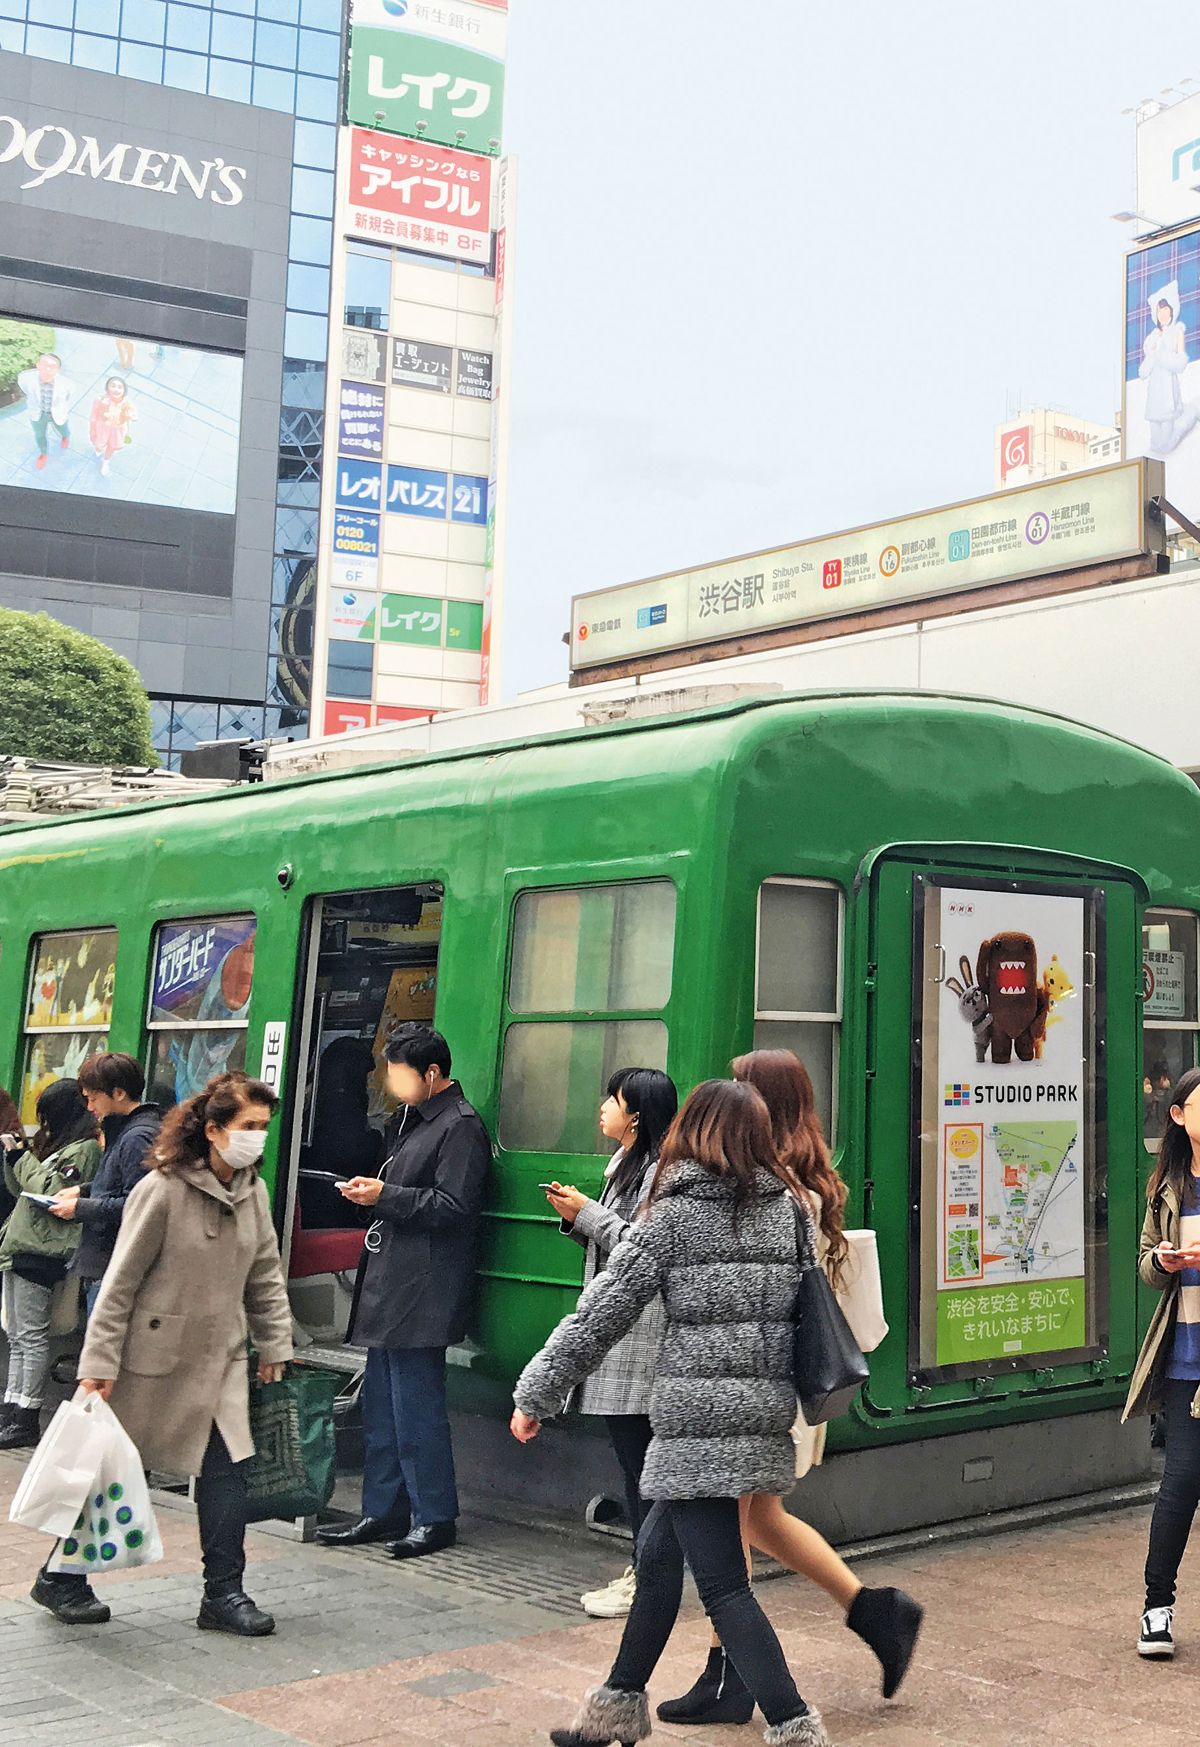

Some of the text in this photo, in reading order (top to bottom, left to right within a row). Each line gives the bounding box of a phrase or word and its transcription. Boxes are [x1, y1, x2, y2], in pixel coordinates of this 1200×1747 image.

[415, 5, 481, 34] 新生銀行
[368, 54, 491, 118] レイク
[361, 144, 481, 182] キャッシングなら
[359, 163, 481, 217] アイフル
[355, 212, 482, 251] 新規会員募集中 8F
[395, 341, 418, 358] 買取
[461, 352, 490, 365] Watch
[394, 354, 449, 376] エージェント
[466, 364, 484, 377] Bag
[458, 374, 492, 389] Jewelry
[341, 472, 481, 514] レオ パレス 21
[1035, 517, 1041, 527] Z
[1051, 502, 1091, 521] 半蔵門線
[336, 526, 364, 538] 0120
[971, 518, 1017, 540] 田園都市線
[1031, 527, 1043, 538] 01
[345, 570, 364, 582] 6F
[773, 562, 815, 578] Shibuya Sta.
[828, 562, 837, 571] TY
[885, 560, 896, 571] 16
[826, 572, 838, 586] 01
[698, 573, 764, 618] 渋谷駅
[381, 607, 441, 632] レイク
[265, 1031, 281, 1087] 出口
[974, 1083, 1078, 1104] STUDIO PARK
[946, 1287, 1076, 1320] 渋谷を安全・安心で、
[962, 1312, 1062, 1342] きれいなまちに
